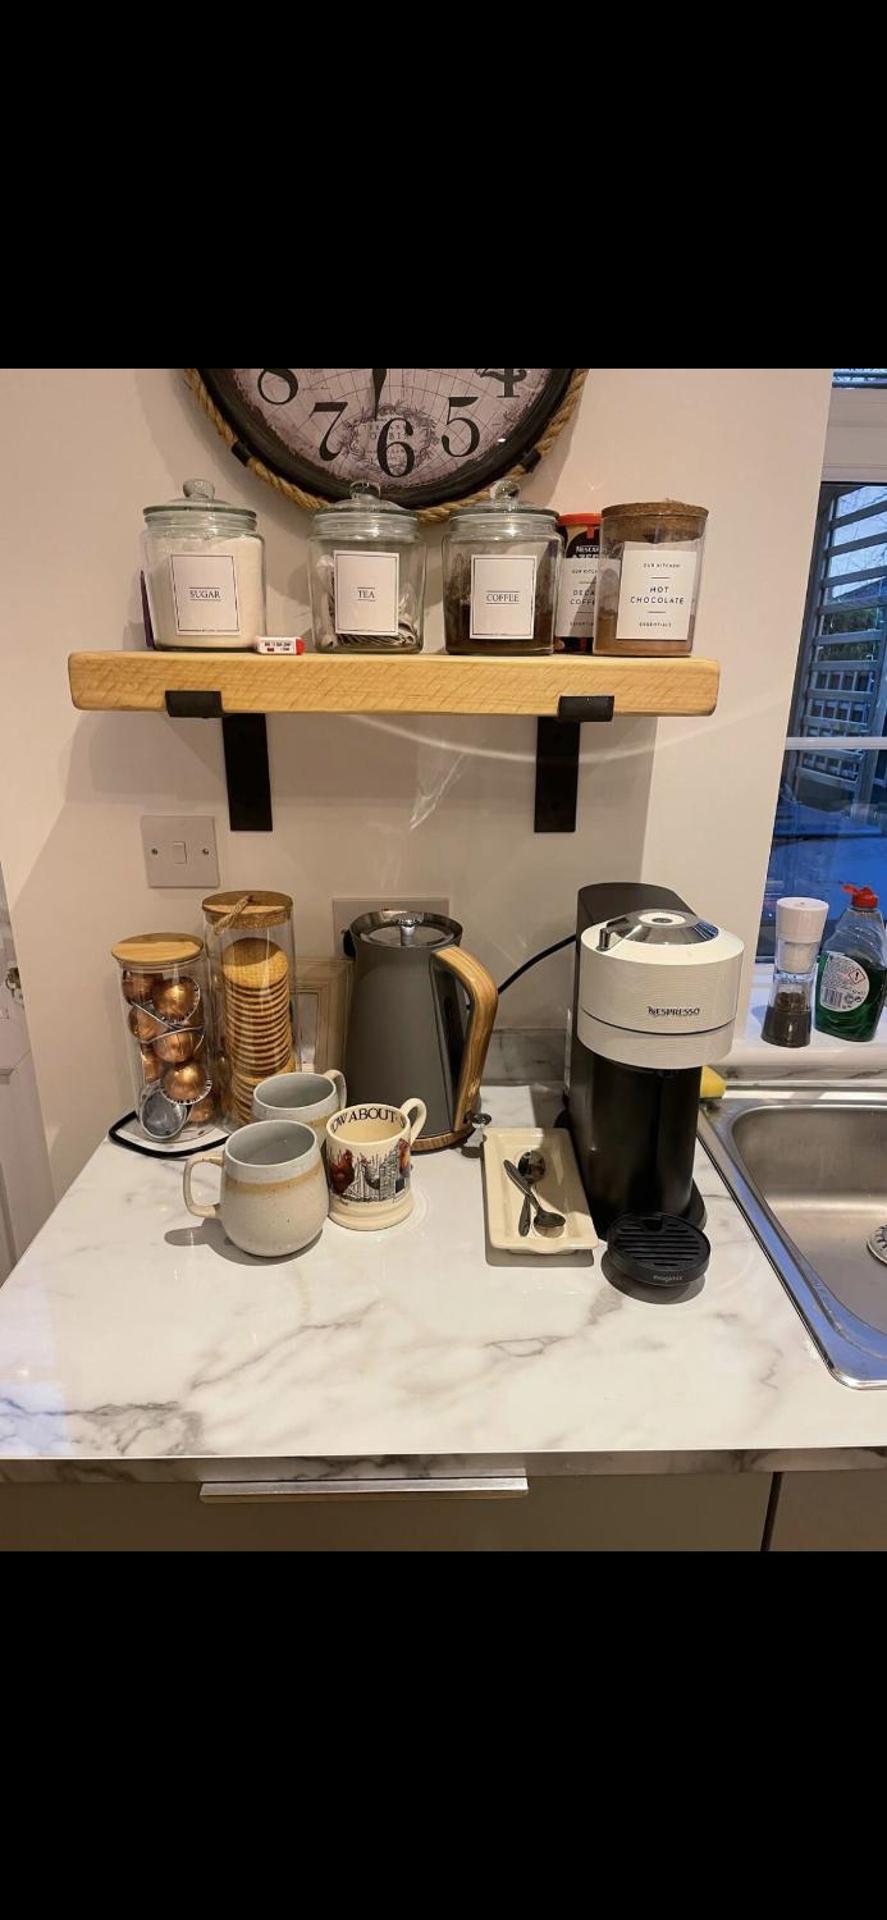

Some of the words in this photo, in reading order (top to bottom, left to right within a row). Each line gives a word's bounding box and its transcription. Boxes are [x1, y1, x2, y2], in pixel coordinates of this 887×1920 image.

[257, 369, 299, 404] 8
[310, 401, 347, 461] 7
[441, 396, 480, 457] 5
[376, 418, 415, 478] 6
[189, 590, 221, 599] SUGAR
[357, 590, 375, 599] TEA
[485, 593, 520, 603] COFFEE
[630, 596, 684, 605] CHOCOLATE
[647, 1006, 700, 1018] NESPRESSO
[349, 1107, 395, 1123] ABOUT
